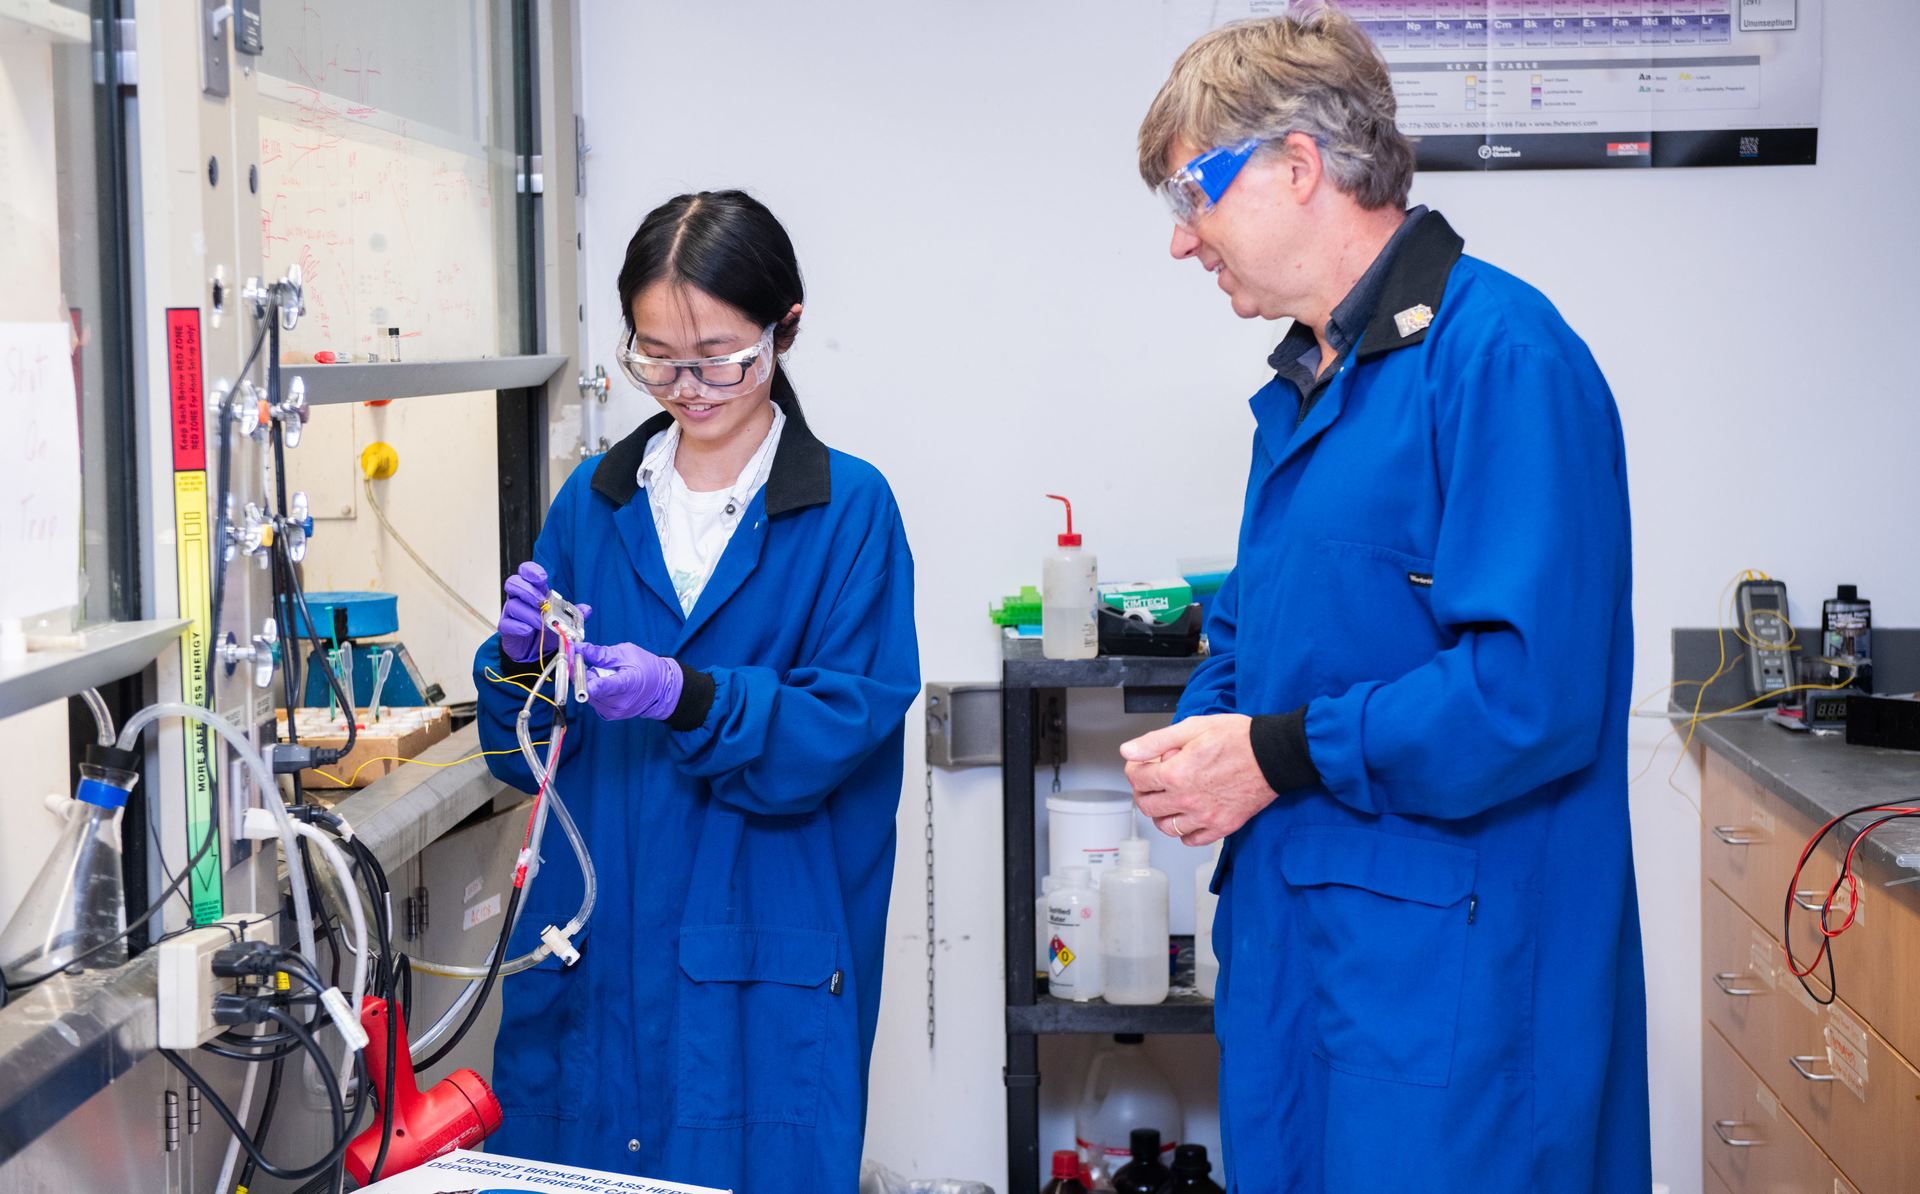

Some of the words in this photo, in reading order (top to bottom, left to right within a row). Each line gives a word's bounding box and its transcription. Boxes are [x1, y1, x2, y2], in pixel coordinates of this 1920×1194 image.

[1436, 21, 1450, 29] Pu
[1465, 21, 1482, 29] Am
[1494, 20, 1512, 29] Cm
[1524, 20, 1538, 28] Bk
[1553, 19, 1565, 28] Cf
[1583, 19, 1596, 28] Es
[1612, 18, 1629, 26] Fm
[1642, 17, 1658, 26] Md
[1671, 17, 1686, 25] No
[1701, 16, 1713, 24] Lr
[1743, 18, 1793, 28] Ununseptium
[1406, 22, 1421, 31] Np
[1446, 63, 1470, 71] KEY
[1500, 62, 1538, 70] TABLE
[1639, 85, 1651, 93] Aa
[175, 325, 183, 350] ZONE
[186, 325, 197, 345] Only!
[176, 353, 184, 371] RED
[177, 374, 185, 401] Below
[189, 395, 197, 408] For
[190, 410, 198, 431] ZONE
[180, 428, 189, 450] Keep
[191, 433, 199, 450] RED
[1123, 597, 1169, 609] KIMTECH
[193, 632, 202, 680] ENERGY
[194, 685, 203, 708] ESS
[196, 723, 204, 754] SAFE
[197, 757, 206, 792] MORE
[1061, 950, 1069, 962] 0
[427, 1162, 502, 1177] DÉPOSER
[501, 1172, 523, 1180] LA
[525, 1175, 603, 1193] VERRERIE
[456, 1157, 525, 1171] DEPOSIT
[523, 1167, 592, 1182] BROKEN
[592, 1177, 646, 1191] GLASS
